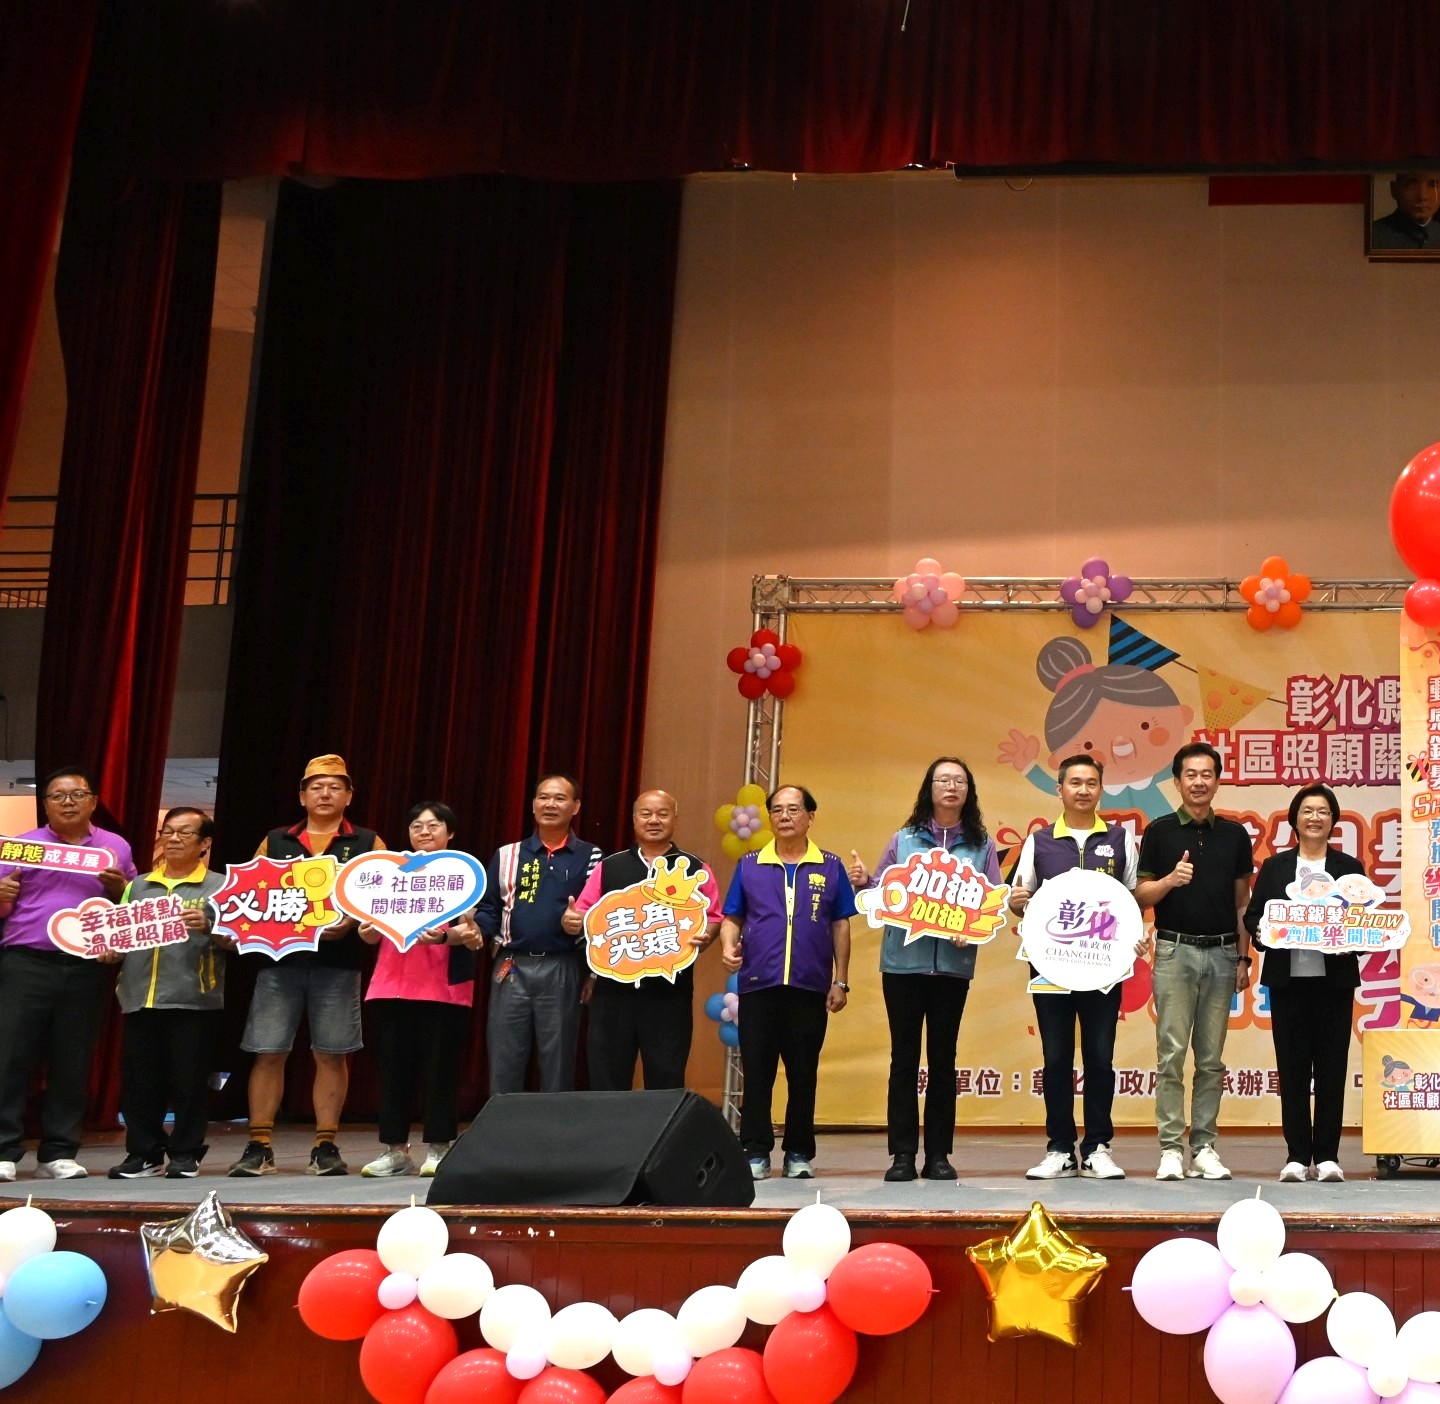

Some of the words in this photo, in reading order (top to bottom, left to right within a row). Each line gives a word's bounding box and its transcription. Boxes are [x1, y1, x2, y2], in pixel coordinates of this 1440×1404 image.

[0, 841, 101, 869] 靜態成果展
[391, 874, 465, 893] 社區照顧
[906, 863, 985, 911] 加油
[79, 896, 183, 933] 幸福據點
[219, 887, 309, 923] 必勝
[370, 896, 445, 915] 關懷據點
[604, 901, 675, 938] 主角
[909, 895, 968, 932] 加油
[1056, 898, 1120, 941] 彰化
[608, 925, 681, 966] 光環
[1079, 940, 1112, 951] 縣政府
[1286, 925, 1385, 947] 齊據樂開懷
[1045, 947, 1112, 962] CHANGHUA
